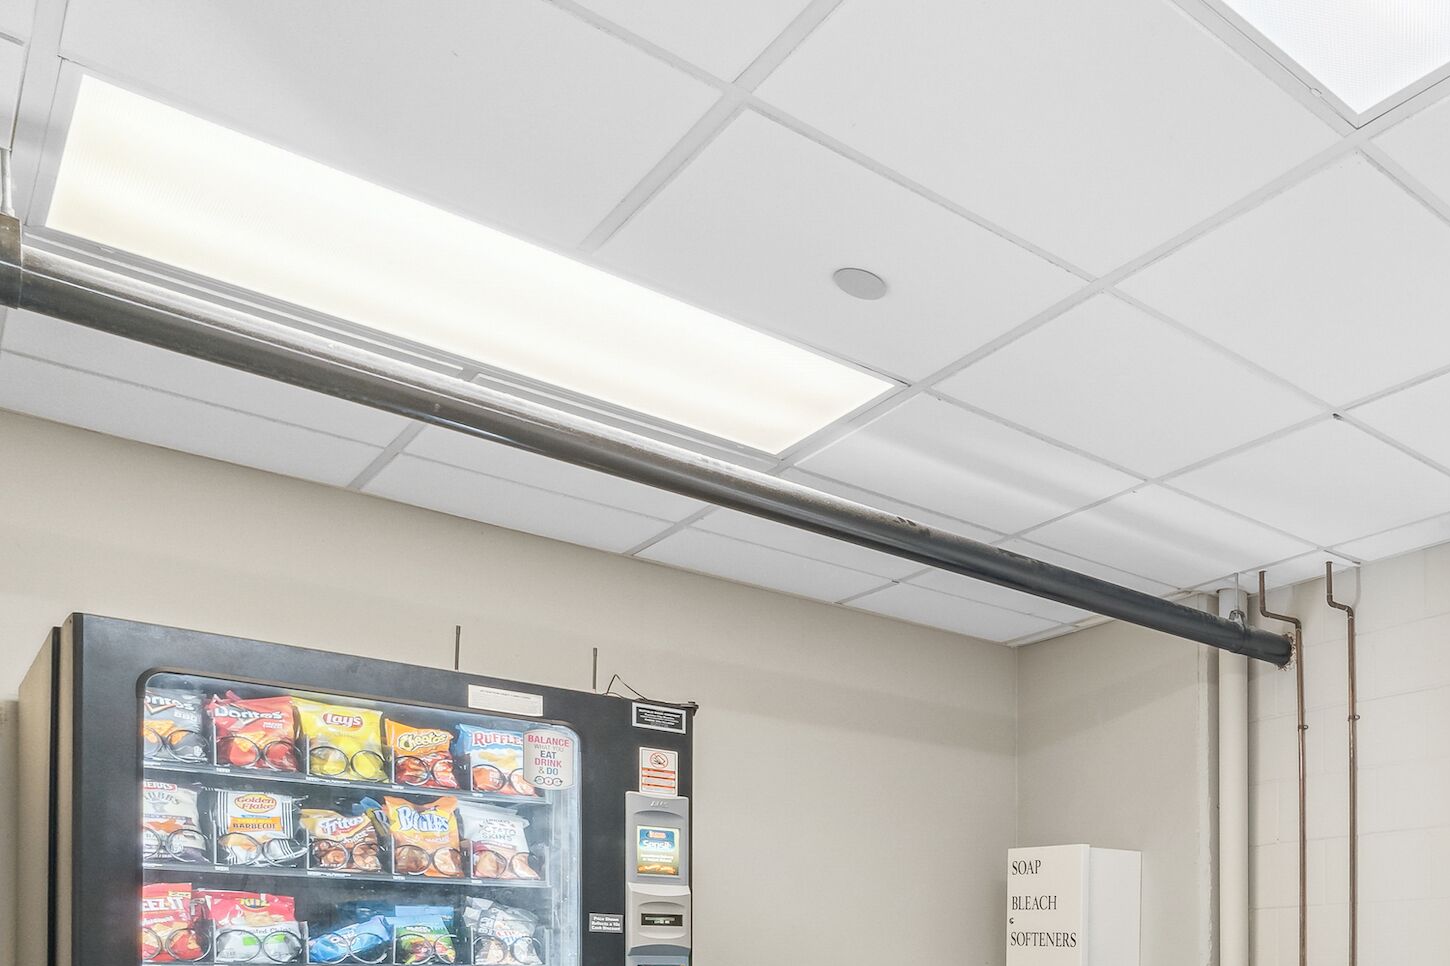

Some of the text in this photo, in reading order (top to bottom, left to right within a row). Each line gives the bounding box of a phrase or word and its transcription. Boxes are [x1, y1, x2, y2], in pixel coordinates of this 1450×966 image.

[215, 706, 284, 721] Doritos
[398, 731, 448, 751] Cheetos
[527, 734, 570, 748] BALANCE
[540, 750, 557, 759] EAT
[534, 758, 562, 768] DRINK
[546, 767, 559, 776] DO
[237, 795, 276, 804] Golden
[241, 802, 274, 810] Flake
[1012, 859, 1042, 876] SOAP
[1012, 895, 1057, 911] BLEACH
[1010, 931, 1077, 948] SOFTENERS
